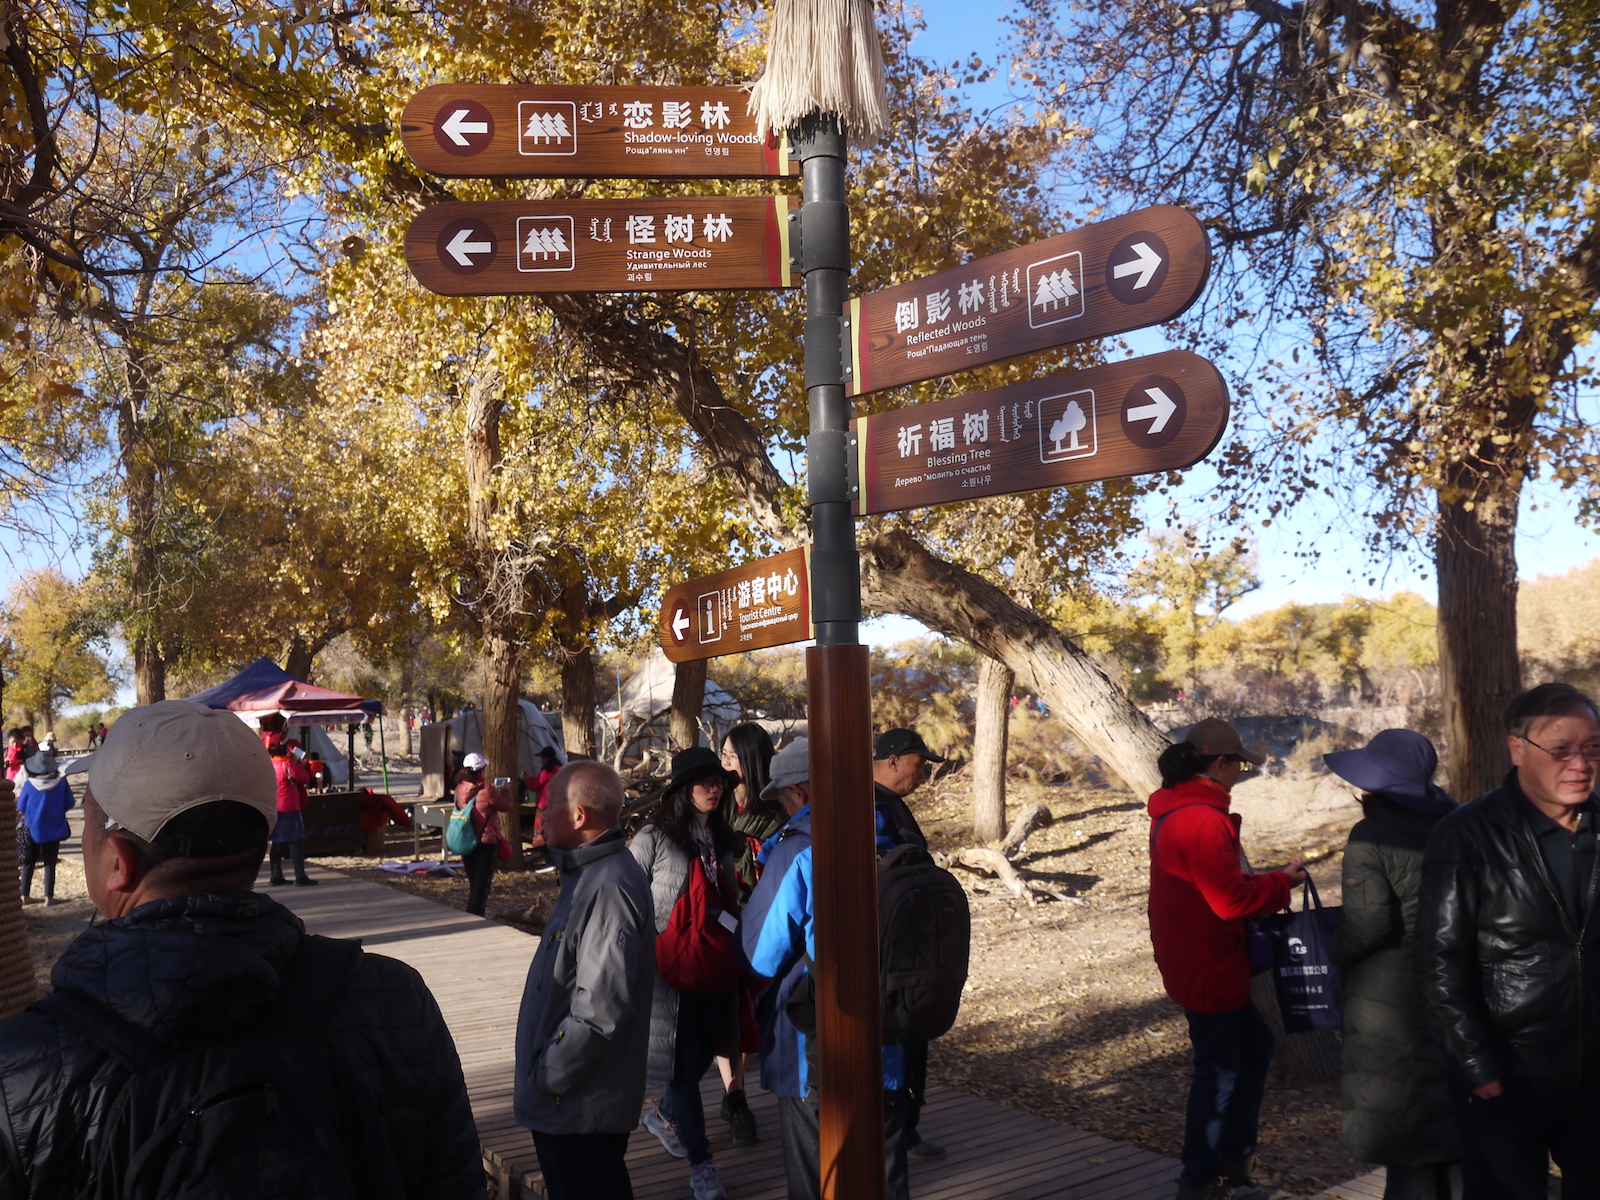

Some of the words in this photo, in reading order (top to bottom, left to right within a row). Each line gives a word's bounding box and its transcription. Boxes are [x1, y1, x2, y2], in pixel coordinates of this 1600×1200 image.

[623, 101, 731, 129] 恋影林
[624, 132, 713, 146] Shadow-loving
[716, 132, 759, 144] Woods
[625, 213, 734, 244] 怪树林
[626, 250, 670, 261] Strange
[672, 248, 712, 258] Woods
[626, 261, 691, 271] Удивительный
[895, 279, 985, 334] 倒影林
[906, 324, 950, 345] Reflected
[952, 315, 987, 333] Woods
[897, 409, 990, 458] 祈福树
[927, 453, 968, 468] Blessing
[969, 449, 991, 460] Tree
[895, 476, 923, 487] Дерево
[961, 464, 992, 474] счастье
[961, 475, 992, 488] 소원나무
[738, 567, 799, 609] 游客中心
[739, 610, 759, 624] Tourist
[760, 606, 782, 619] Centre
